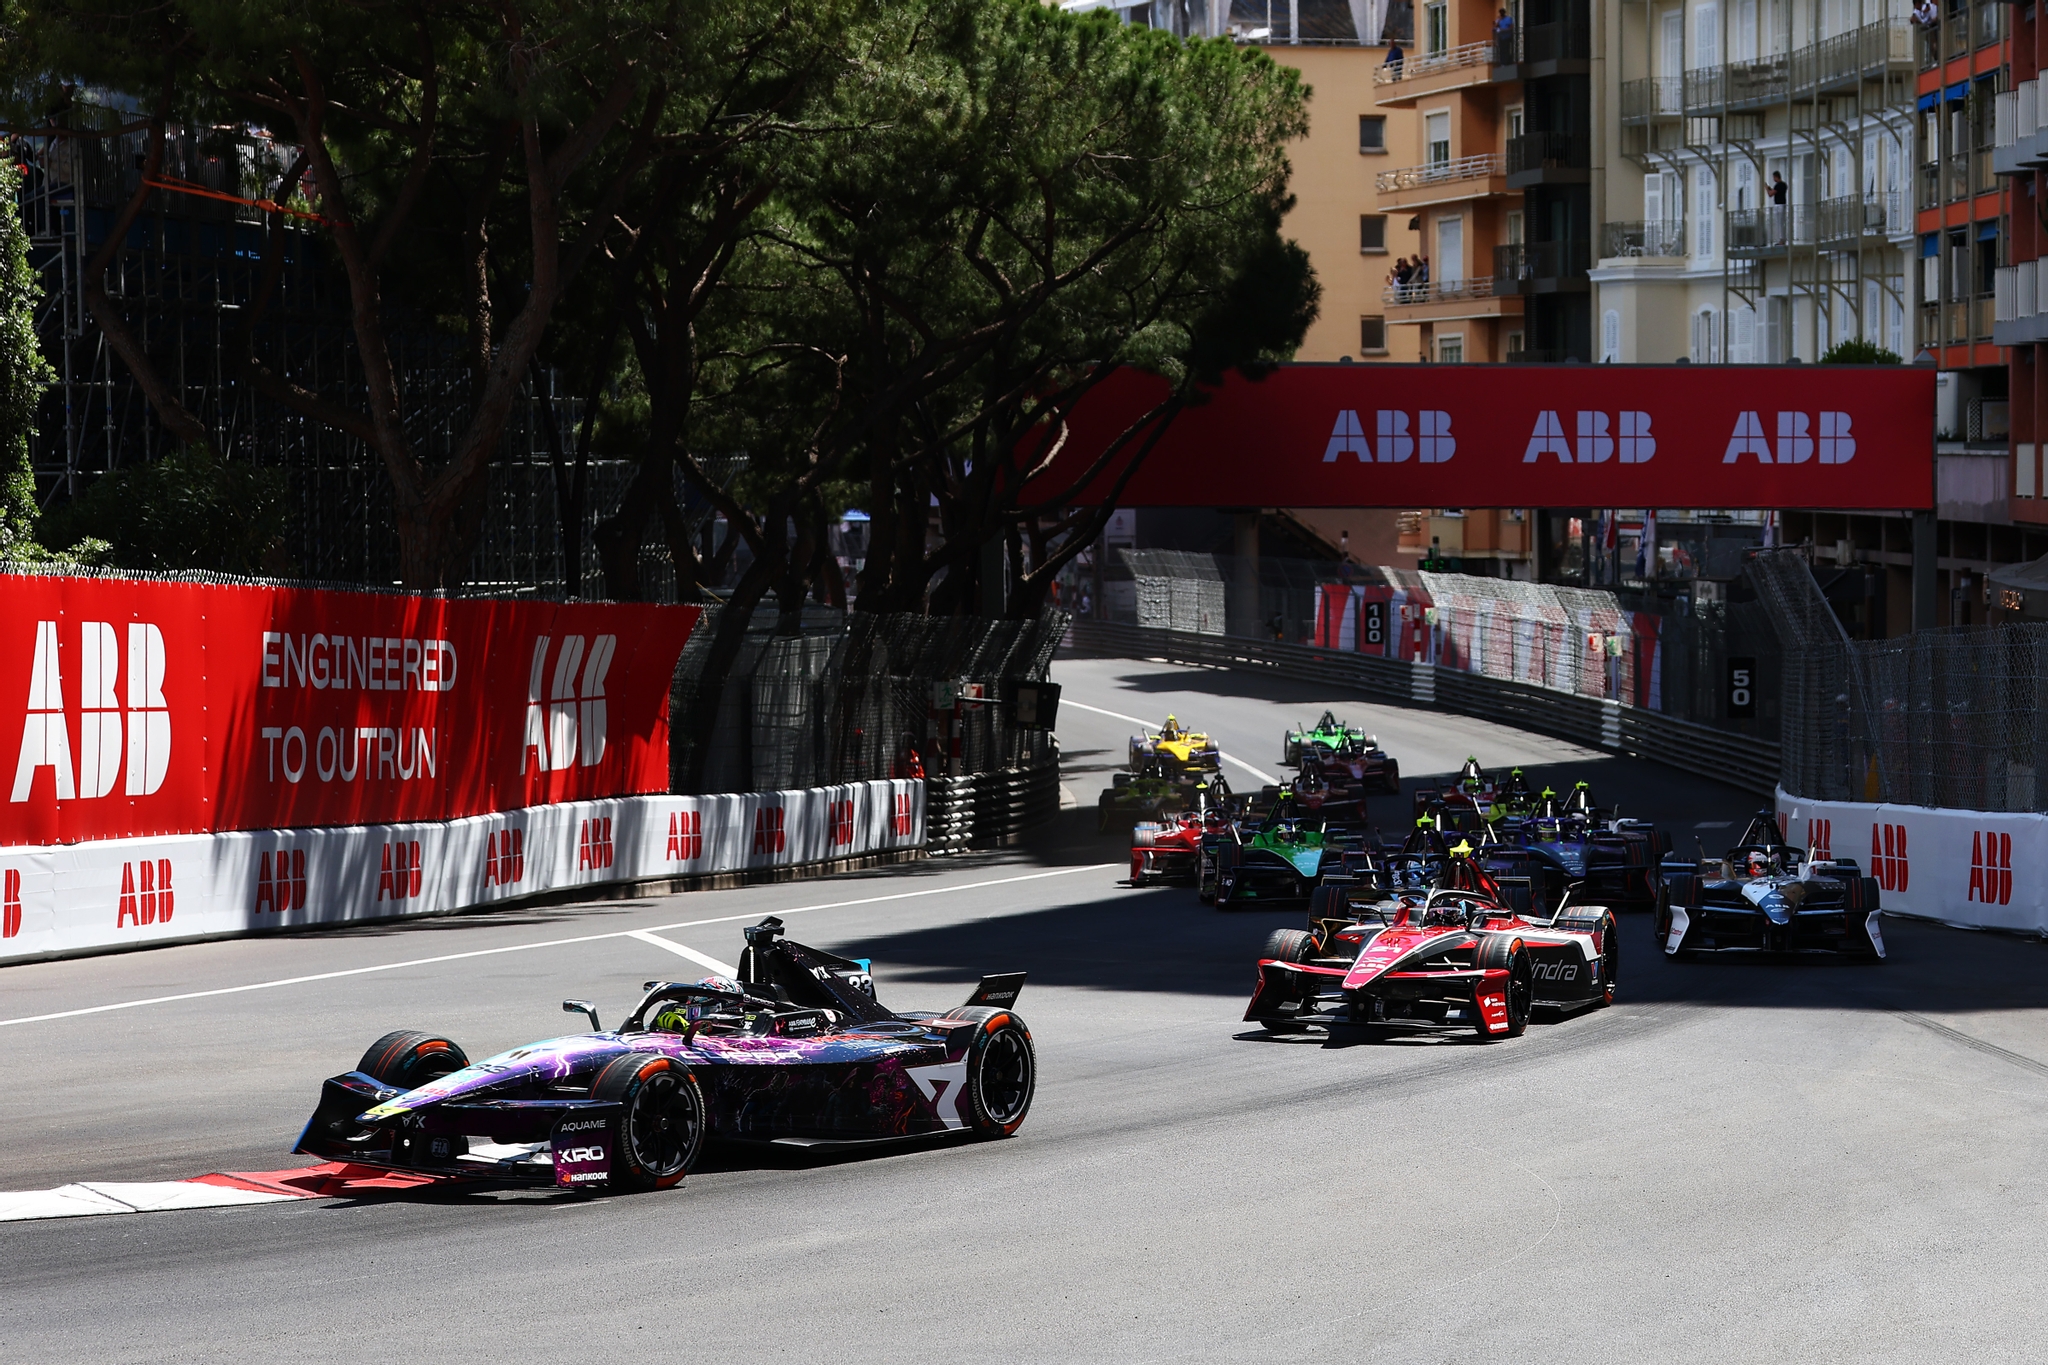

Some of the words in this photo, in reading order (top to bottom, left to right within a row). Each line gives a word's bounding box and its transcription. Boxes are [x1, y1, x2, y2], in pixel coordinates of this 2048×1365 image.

[1322, 410, 1456, 463] ABB
[1522, 410, 1656, 463] ABB
[1722, 411, 1857, 464] ABB
[262, 631, 457, 692] ENGINEERED
[1733, 670, 1750, 705] 50
[11, 621, 171, 803] ABB
[519, 634, 617, 776] ABB
[262, 726, 305, 784] TO
[315, 726, 436, 783] OUTRUN
[667, 811, 701, 861] ABB
[754, 807, 785, 855] ABB
[829, 800, 854, 847] ABB
[890, 793, 911, 837] ABB
[377, 841, 422, 902] ABB
[484, 829, 524, 889] ABB
[580, 816, 614, 872] ABB
[1871, 823, 1909, 893] ABB
[1968, 831, 2013, 905] ABB
[117, 859, 174, 929] ABB
[255, 850, 306, 914] ABB
[1532, 958, 1578, 981] indra
[558, 1145, 604, 1163] KIRO
[561, 1119, 607, 1132] AQUAME
